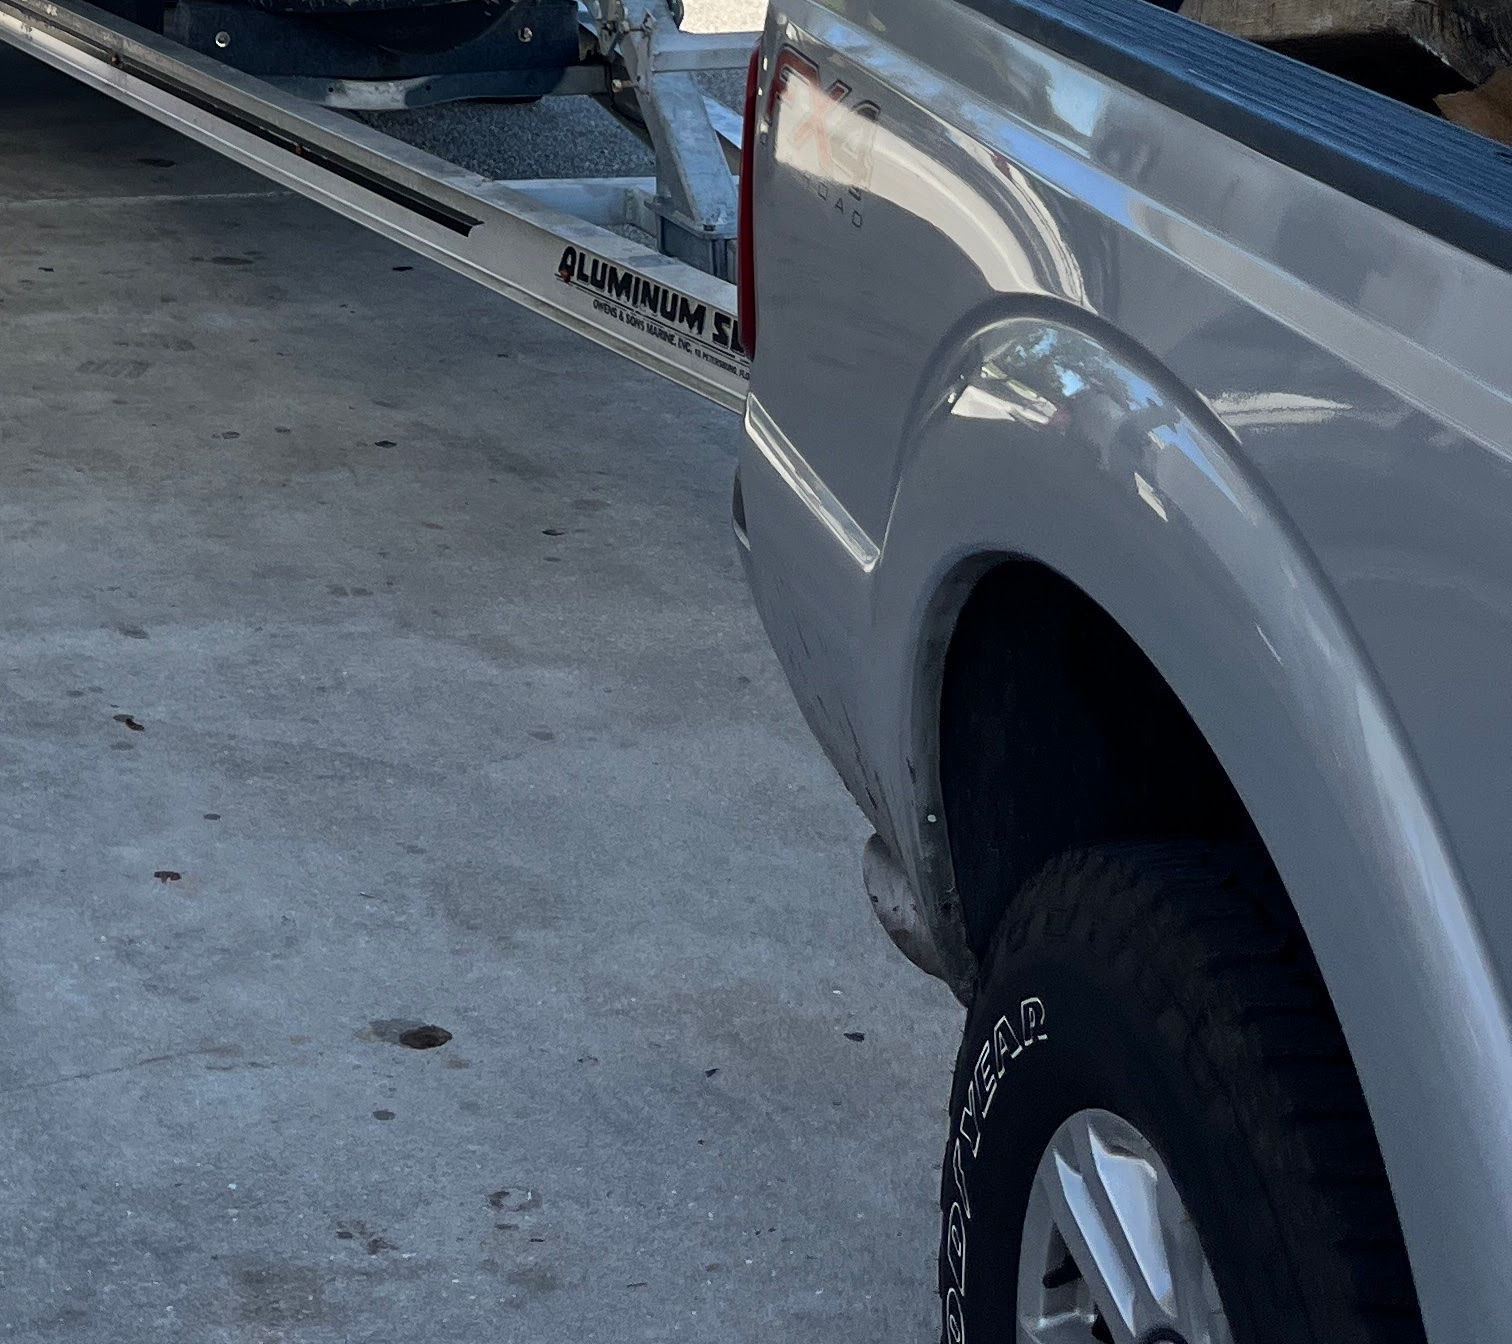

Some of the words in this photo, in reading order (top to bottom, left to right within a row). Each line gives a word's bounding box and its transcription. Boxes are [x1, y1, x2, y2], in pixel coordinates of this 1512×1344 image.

[558, 246, 706, 335] ALUMINUM
[712, 312, 746, 354] SL
[946, 997, 1048, 1344] ODYEAR
